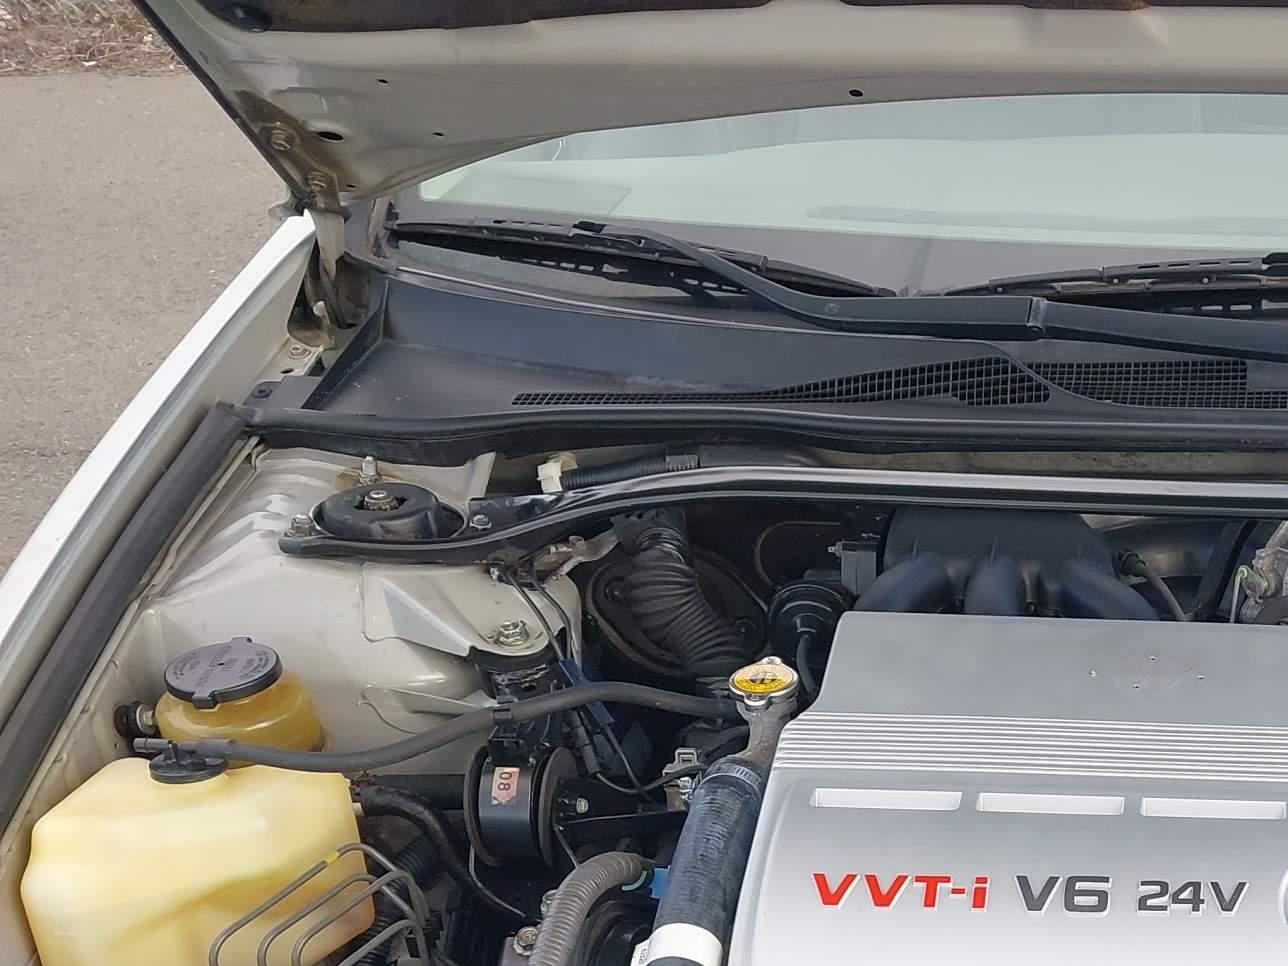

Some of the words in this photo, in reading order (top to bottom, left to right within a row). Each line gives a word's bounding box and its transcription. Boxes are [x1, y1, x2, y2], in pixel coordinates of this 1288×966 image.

[812, 873, 990, 911] VVT-i
[1014, 875, 1112, 914] V6
[1136, 880, 1250, 915] 24V
